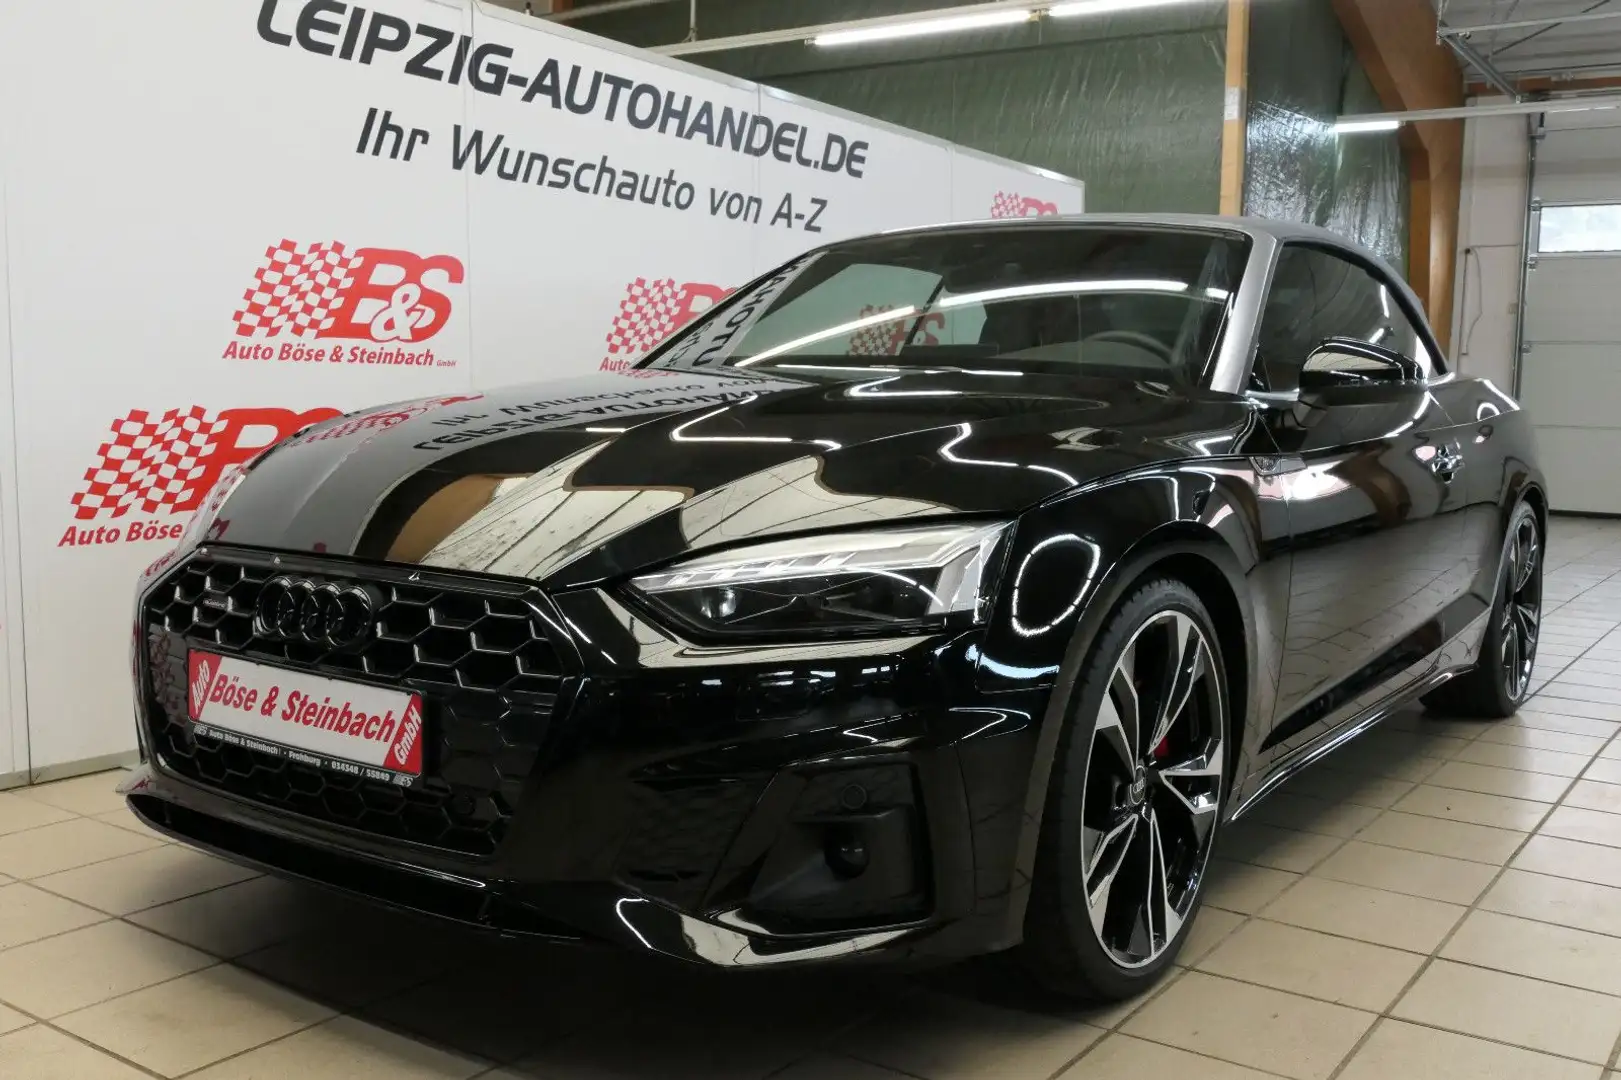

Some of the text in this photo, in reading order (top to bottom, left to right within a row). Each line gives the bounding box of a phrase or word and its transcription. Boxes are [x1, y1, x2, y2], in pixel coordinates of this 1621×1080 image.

[256, 0, 870, 179] LEIPZIG-AUTOHANDEL.DE
[356, 107, 828, 233] Ihr Wunschauto von A-Z
[222, 341, 457, 368] Auto Böse & Steinbach GmbH
[57, 520, 184, 547] Auto Böse
[192, 660, 210, 715] Auto
[209, 674, 258, 712] Böse
[261, 686, 280, 717] &
[281, 690, 397, 743] Steinbach
[394, 703, 423, 765] GmbH
[247, 739, 279, 754] Steinbach
